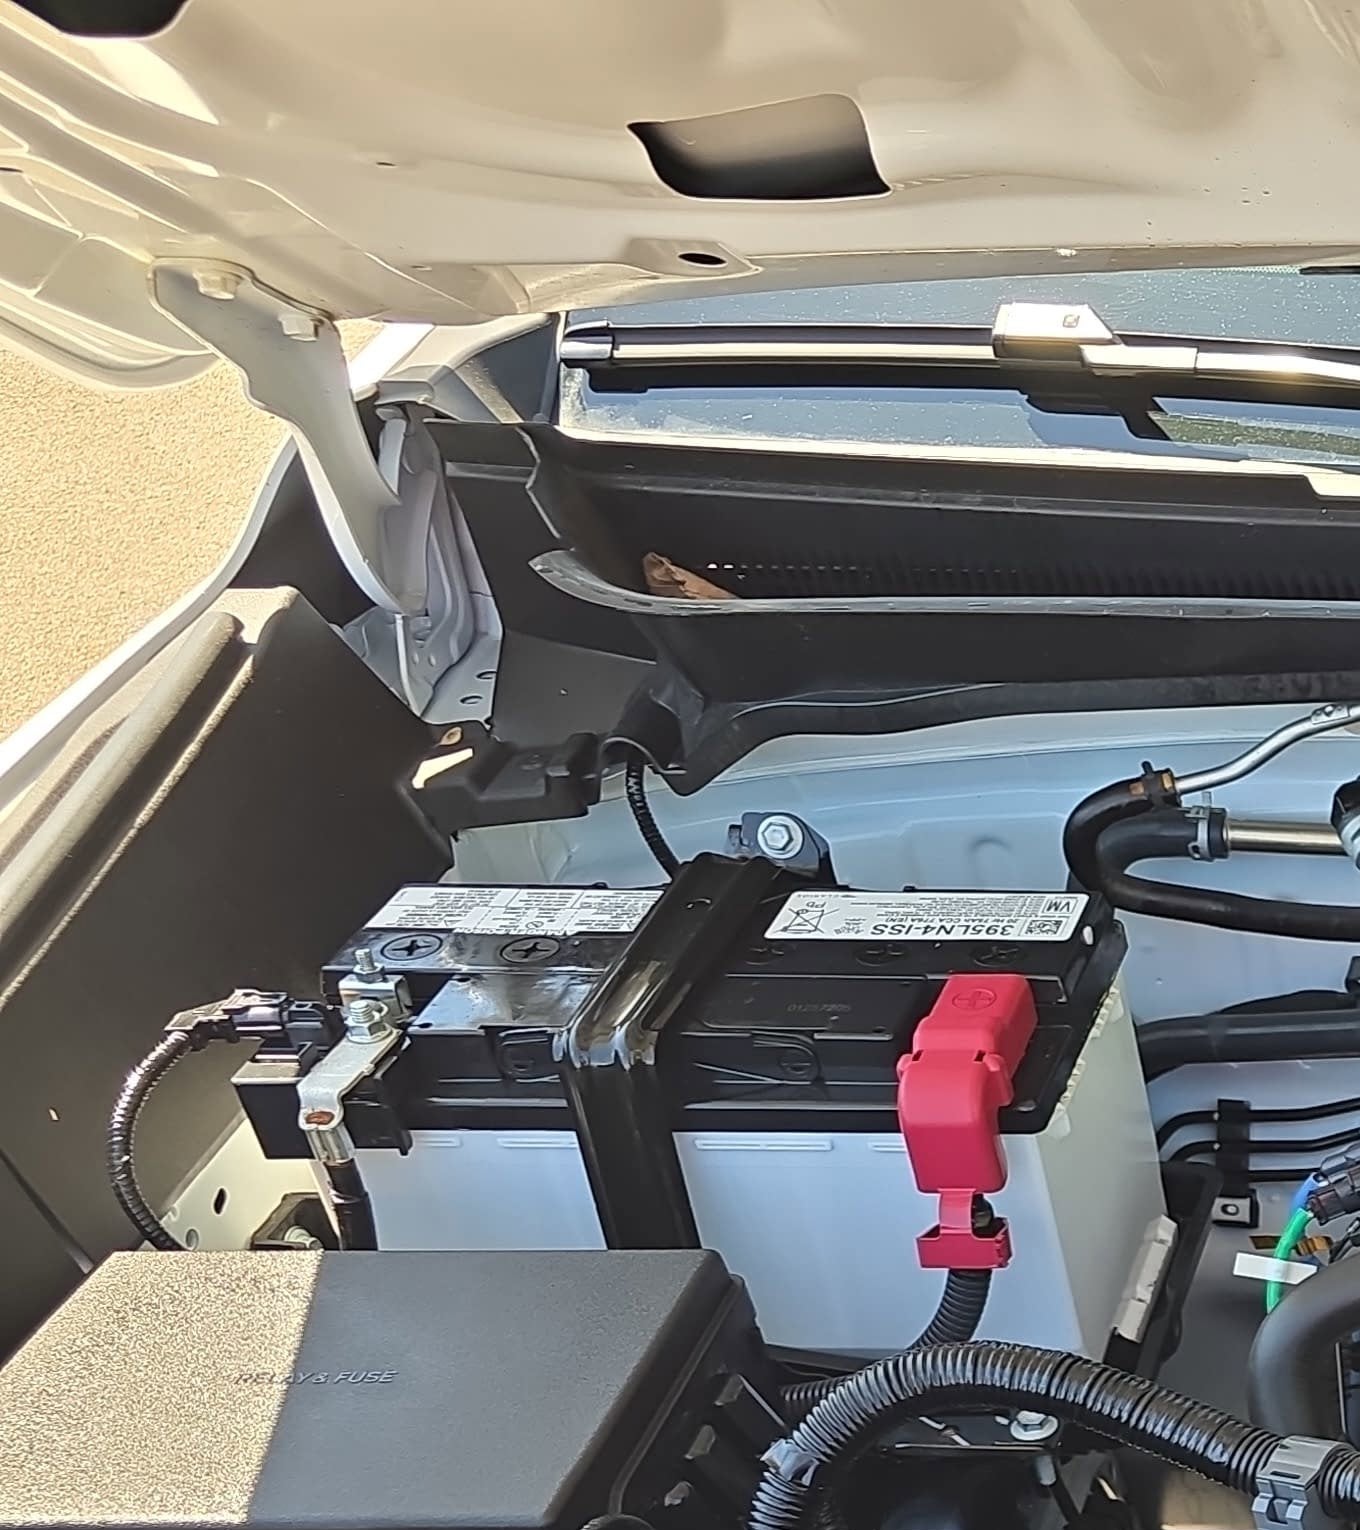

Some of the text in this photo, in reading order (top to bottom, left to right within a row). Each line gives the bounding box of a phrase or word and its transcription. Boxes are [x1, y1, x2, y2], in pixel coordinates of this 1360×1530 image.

[1047, 899, 1072, 913] VM
[869, 923, 1015, 936] 395LN4-ISS
[313, 1371, 329, 1384] &
[332, 1369, 399, 1384] FUSE
